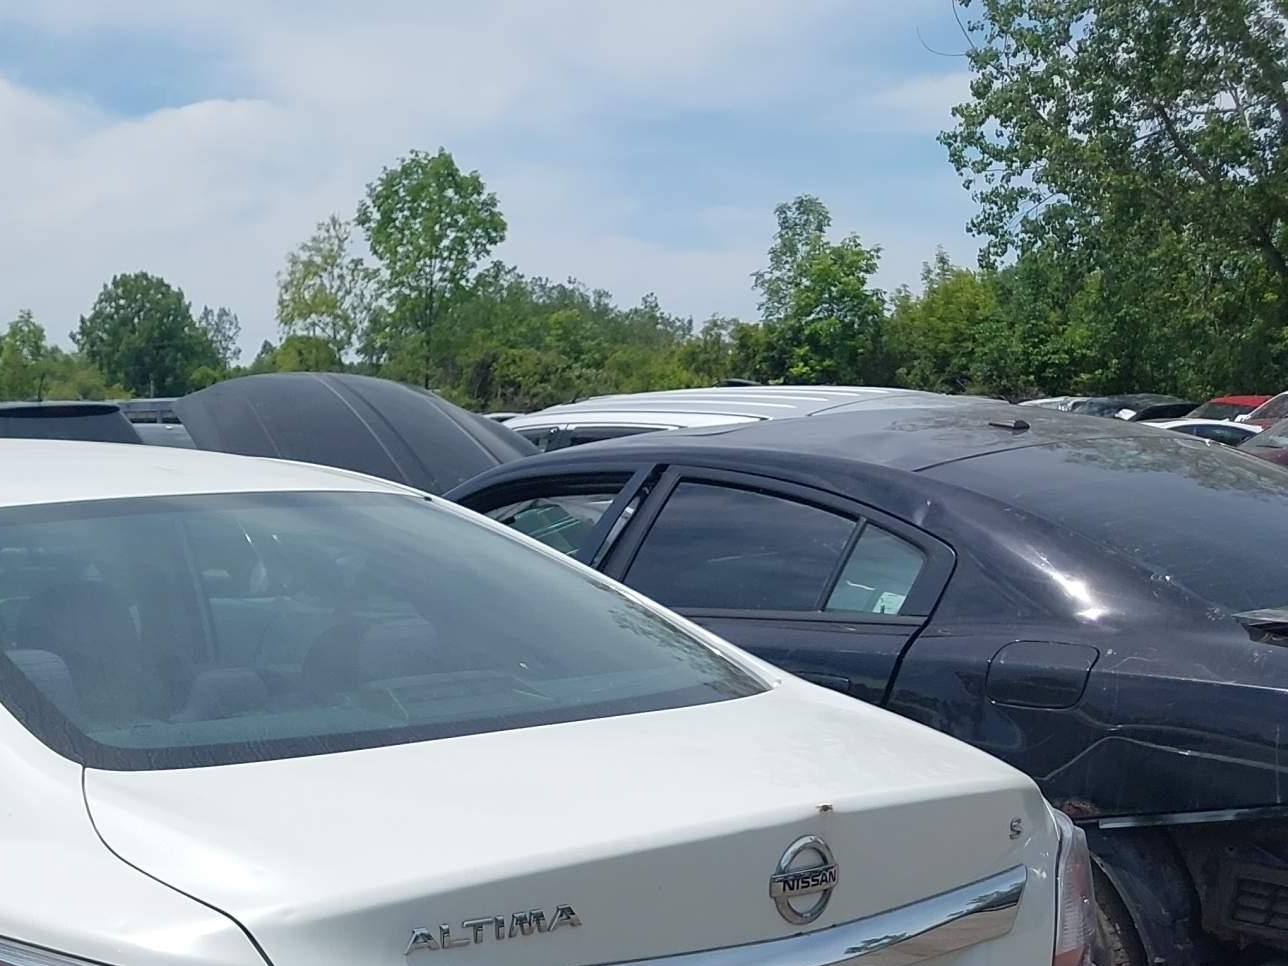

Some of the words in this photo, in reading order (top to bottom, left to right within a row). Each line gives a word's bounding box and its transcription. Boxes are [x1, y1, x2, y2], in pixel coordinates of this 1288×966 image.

[1008, 817, 1024, 840] S
[781, 868, 837, 893] NISSAN
[404, 903, 583, 956] ALTIMA
